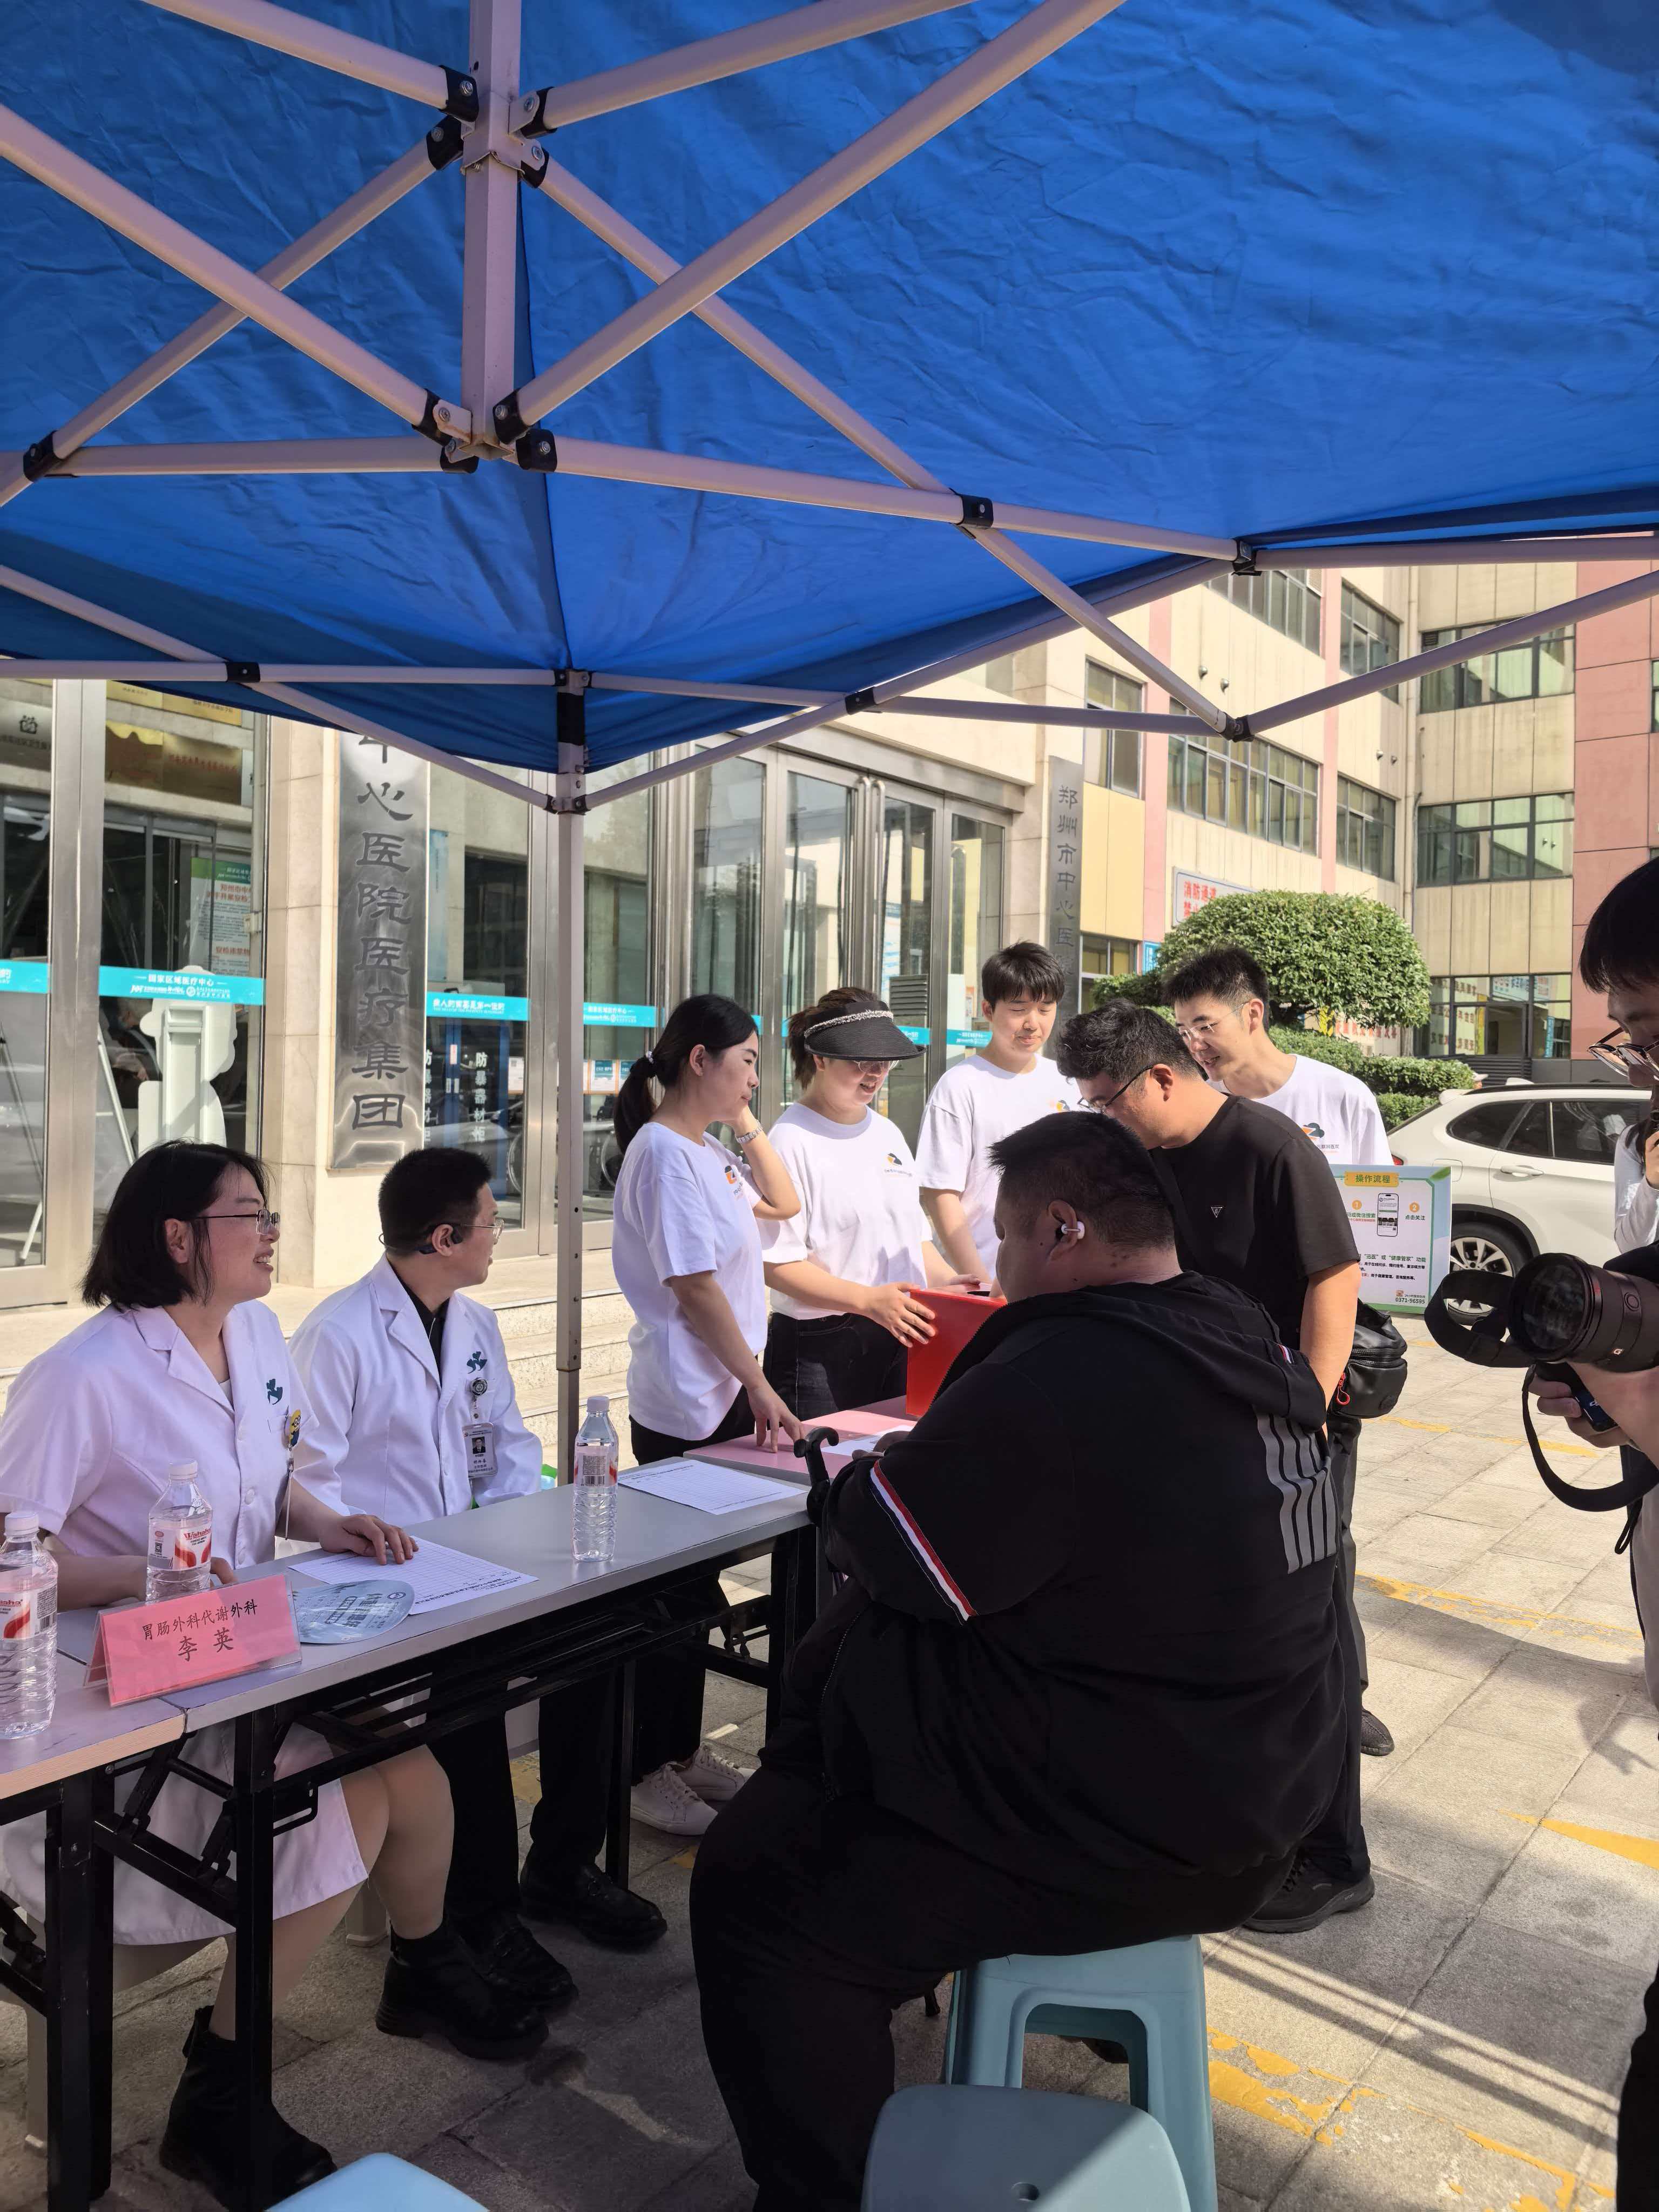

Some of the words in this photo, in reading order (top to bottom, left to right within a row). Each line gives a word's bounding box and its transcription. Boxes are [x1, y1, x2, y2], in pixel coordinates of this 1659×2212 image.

[148, 974, 214, 987] 国家区域医疗中心
[471, 1052, 488, 1142] 防暴器材柜
[1355, 1175, 1391, 1183] 操作流程
[184, 1528, 212, 1539] Wahaha
[142, 1599, 258, 1641] 胃肠外科代谢外科
